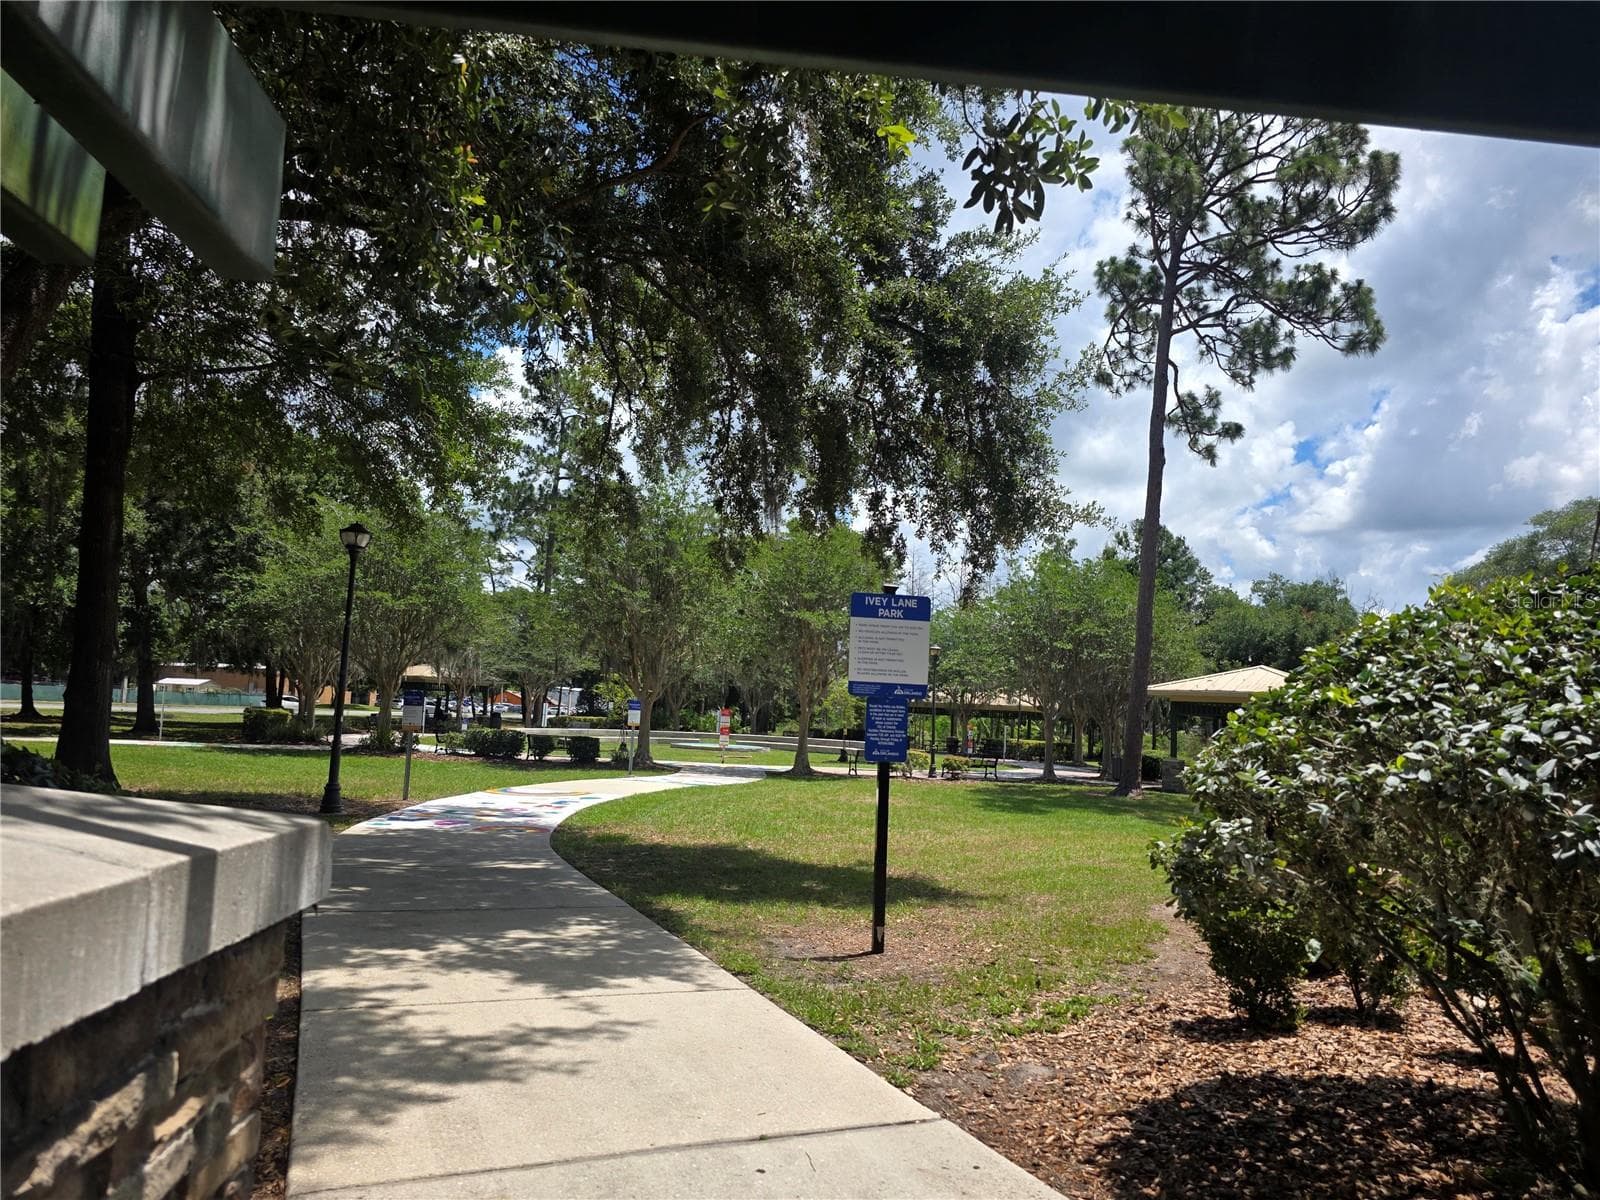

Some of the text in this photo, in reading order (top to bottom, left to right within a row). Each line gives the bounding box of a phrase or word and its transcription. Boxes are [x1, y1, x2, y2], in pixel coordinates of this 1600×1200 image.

[865, 596, 918, 608] IVEY LANE
[878, 608, 904, 618] PARK
